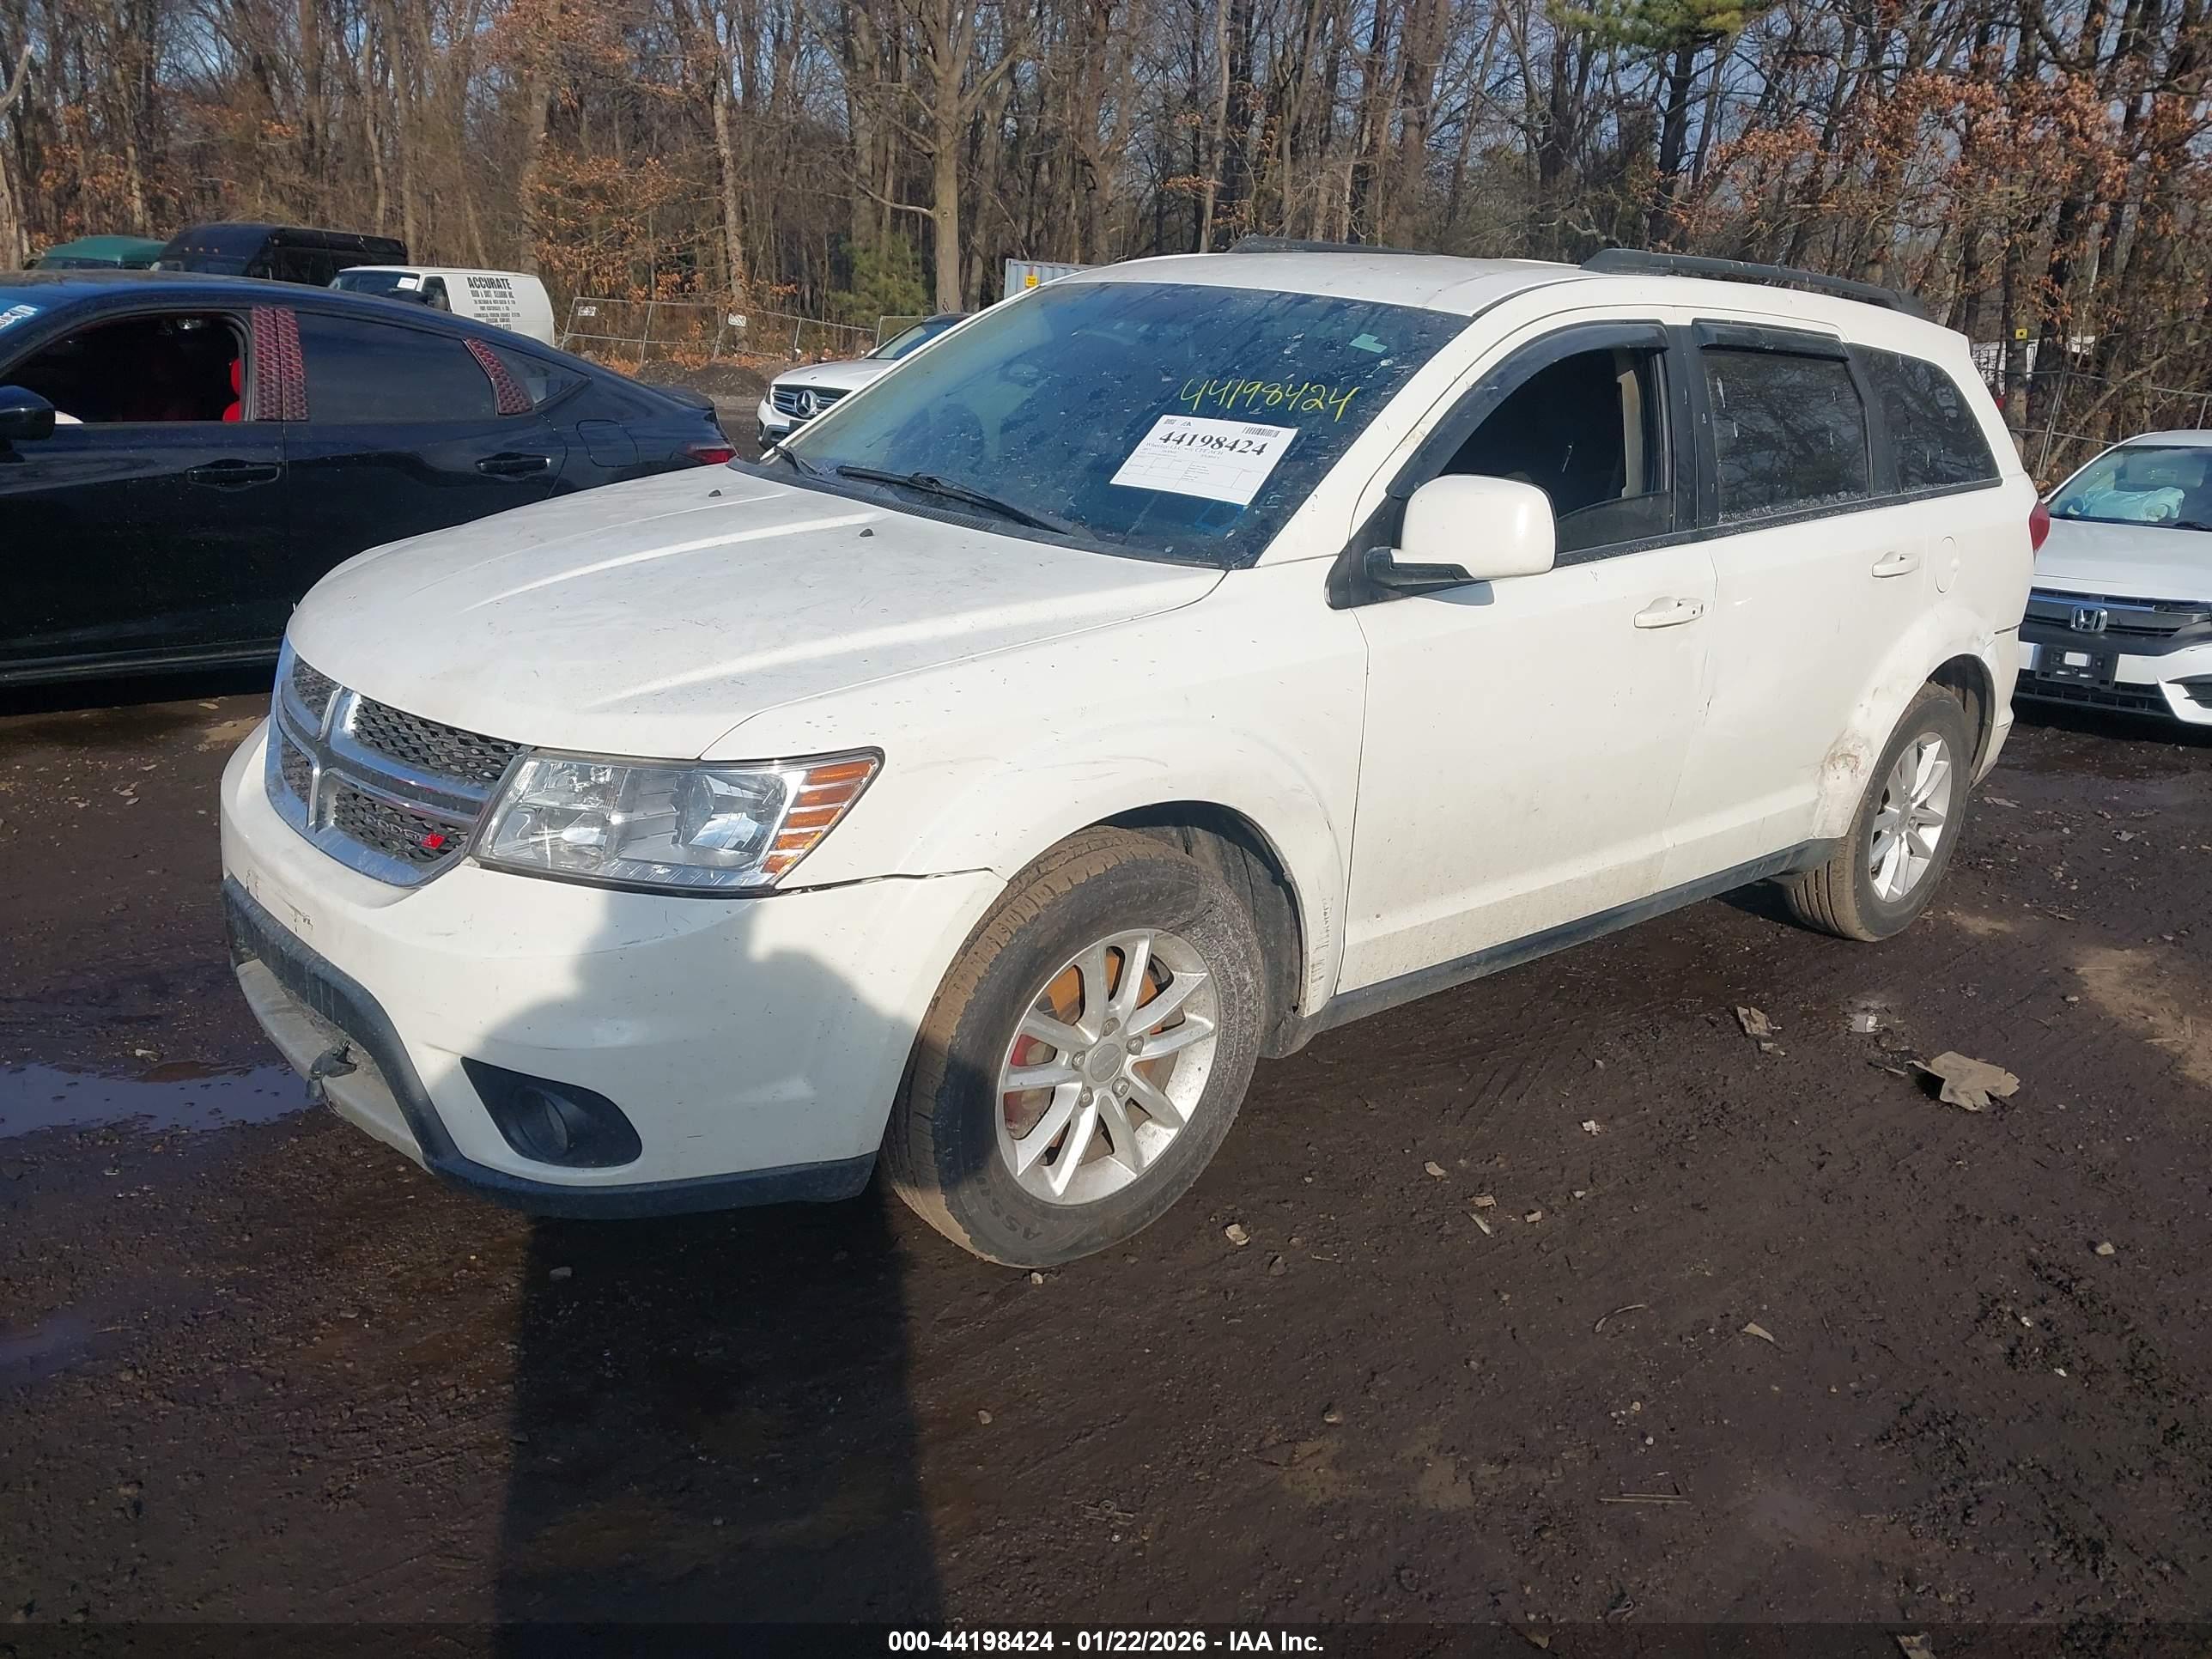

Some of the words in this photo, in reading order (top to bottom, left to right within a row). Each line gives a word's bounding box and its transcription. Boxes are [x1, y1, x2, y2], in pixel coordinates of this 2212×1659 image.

[467, 276, 512, 289] ACCURATE
[1179, 378, 1361, 422] 44198424
[1158, 431, 1269, 456] 44198424
